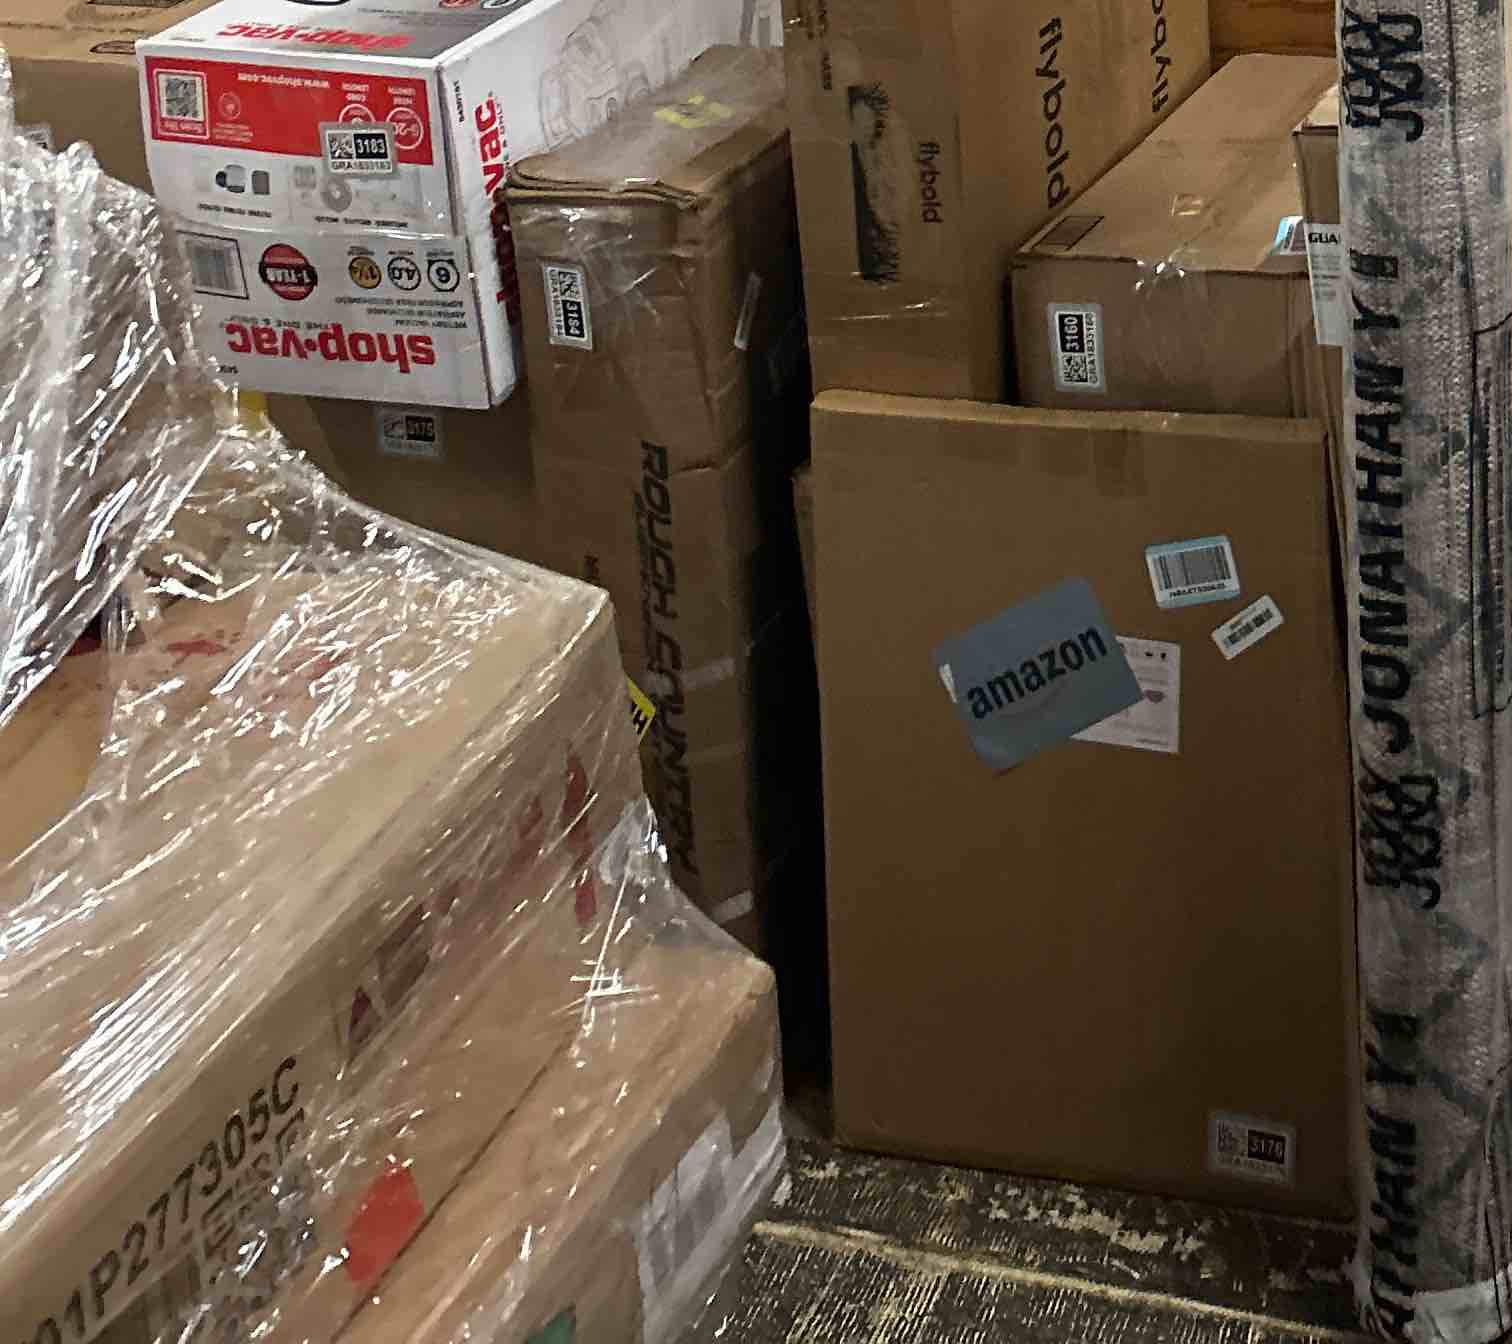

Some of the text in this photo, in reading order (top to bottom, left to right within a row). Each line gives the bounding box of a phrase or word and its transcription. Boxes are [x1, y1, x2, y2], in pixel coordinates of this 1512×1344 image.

[355, 134, 387, 155] 3183
[1035, 16, 1071, 209] flybold
[918, 141, 944, 225] flybold
[1308, 232, 1341, 244] GUA
[564, 300, 582, 339] 3184
[640, 439, 679, 620] ROUGH
[966, 625, 1109, 721] amazon
